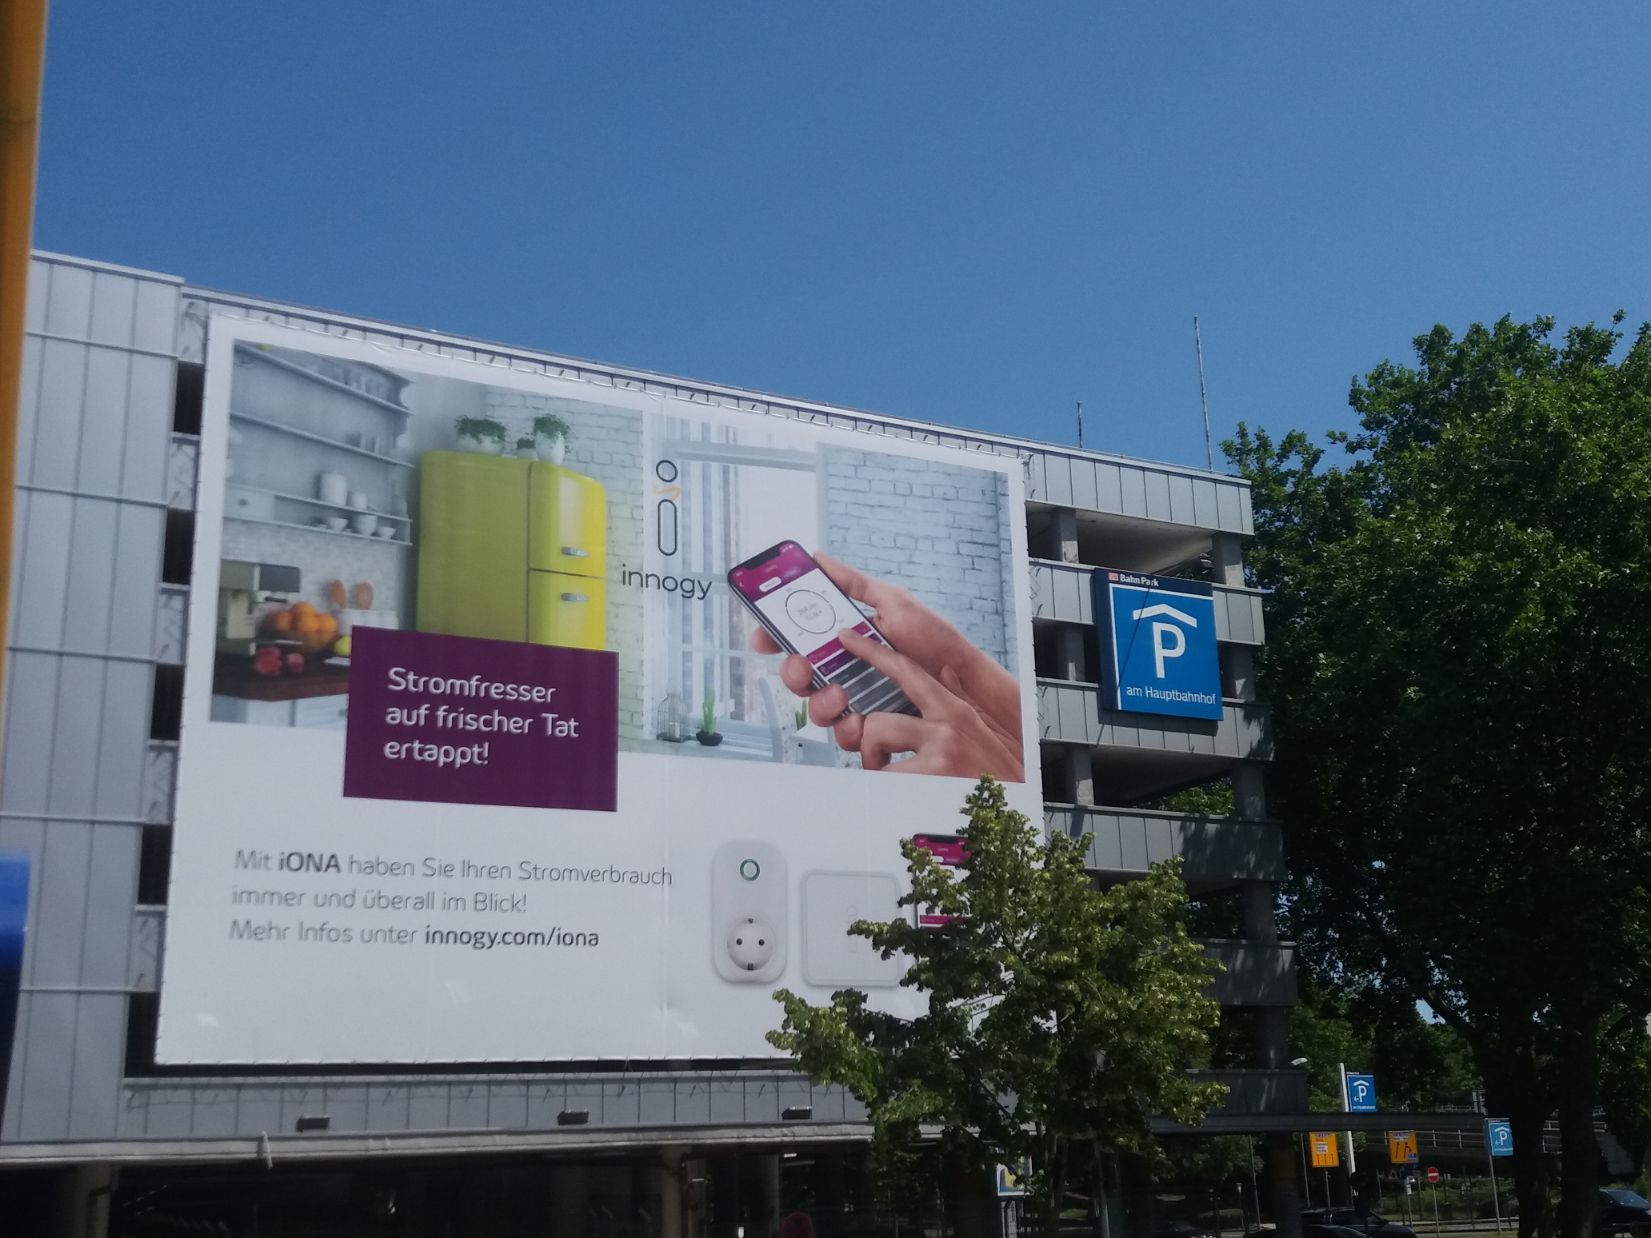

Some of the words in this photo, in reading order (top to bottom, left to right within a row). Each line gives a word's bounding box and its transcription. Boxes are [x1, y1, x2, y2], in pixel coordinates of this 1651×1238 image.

[621, 563, 713, 600] innogy
[1120, 574, 1140, 584] Bahn
[1152, 621, 1186, 679] P
[387, 666, 556, 703] Stromfresser
[1126, 686, 1143, 697] am
[1145, 685, 1217, 705] Hauptbahnhof
[385, 704, 431, 728] auf
[436, 706, 534, 734] frischer
[541, 713, 580, 737] Tat
[384, 740, 490, 768] ertappt!
[234, 849, 273, 871] Mit
[278, 851, 342, 873] iONA
[347, 854, 415, 877] haben
[422, 858, 456, 878] Sie
[461, 859, 512, 880] Ihren
[518, 861, 673, 887] Stromverbrauch
[231, 887, 304, 906] immer
[313, 888, 356, 908] und
[363, 888, 435, 910] überall
[441, 892, 468, 911] im
[473, 893, 528, 913] Blick!
[229, 919, 291, 942] Mehr
[298, 921, 354, 944] Infos
[359, 925, 419, 945] unter
[424, 925, 600, 951] innogy.com/iona
[1358, 1085, 1367, 1103] P
